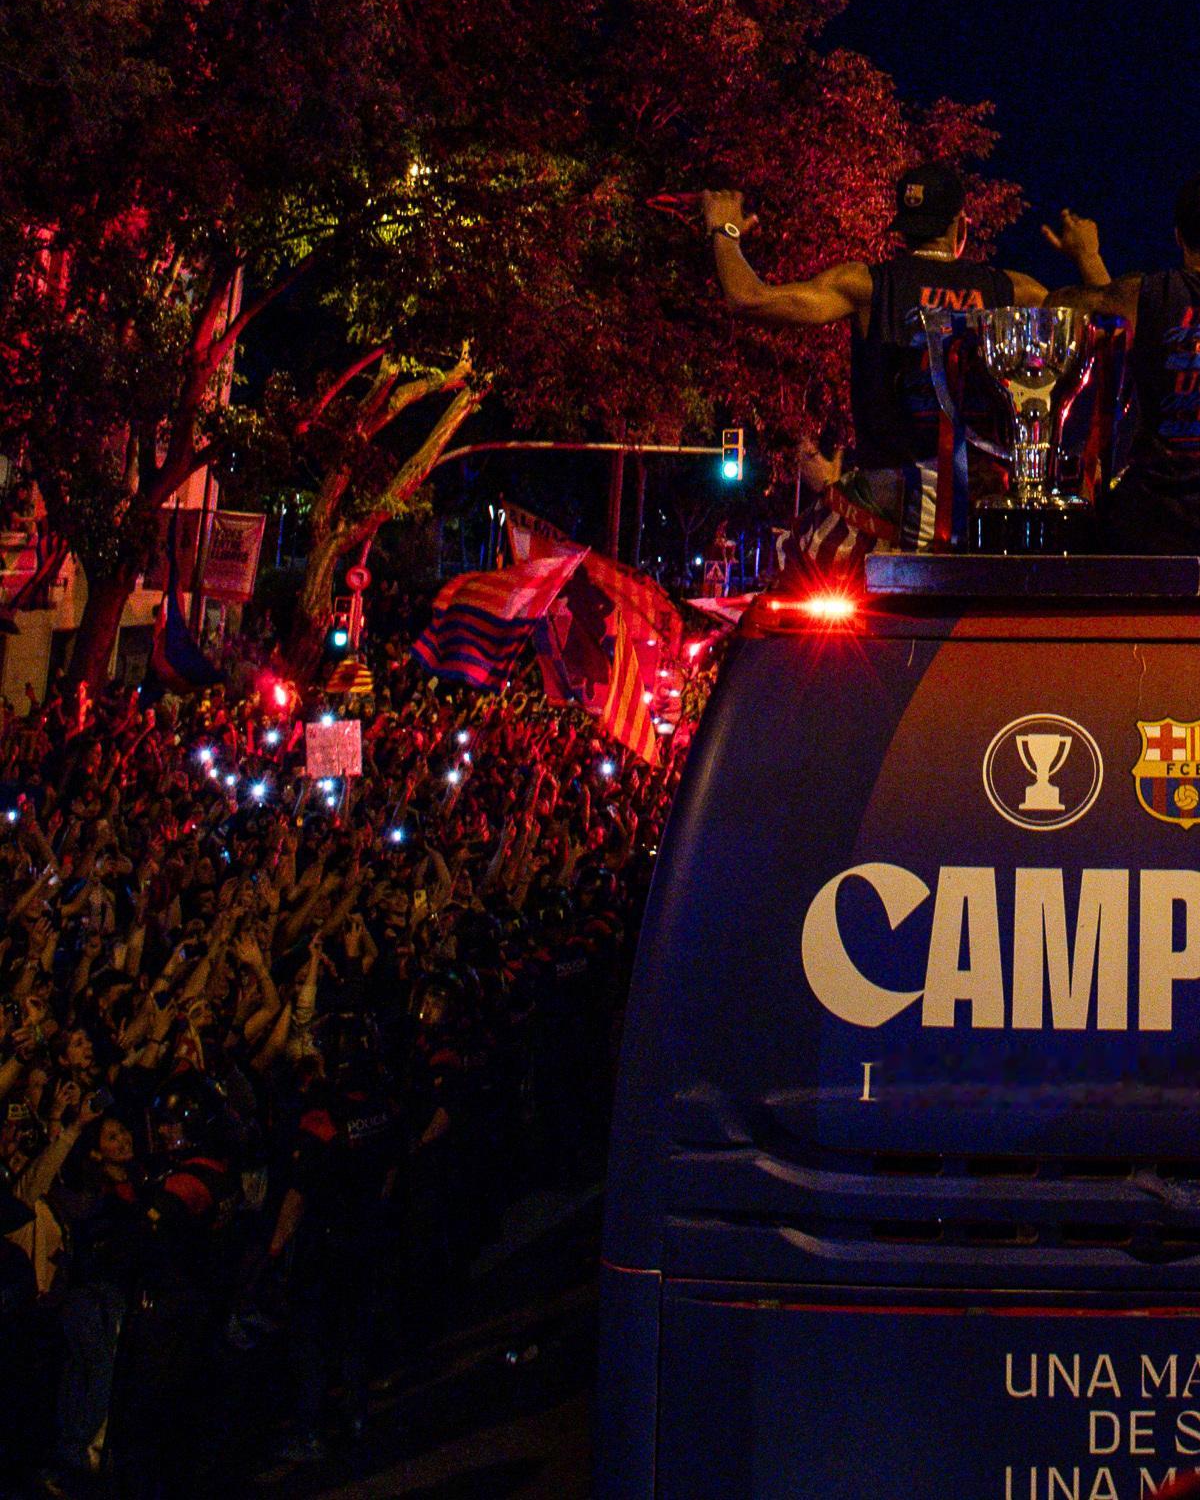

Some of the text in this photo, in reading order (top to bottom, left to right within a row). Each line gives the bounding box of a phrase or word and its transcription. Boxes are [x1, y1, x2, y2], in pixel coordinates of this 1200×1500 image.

[920, 286, 984, 310] UNA
[1005, 1352, 1122, 1399] UNA
[1089, 1409, 1157, 1456] DE
[1005, 1466, 1119, 1500] UNA
